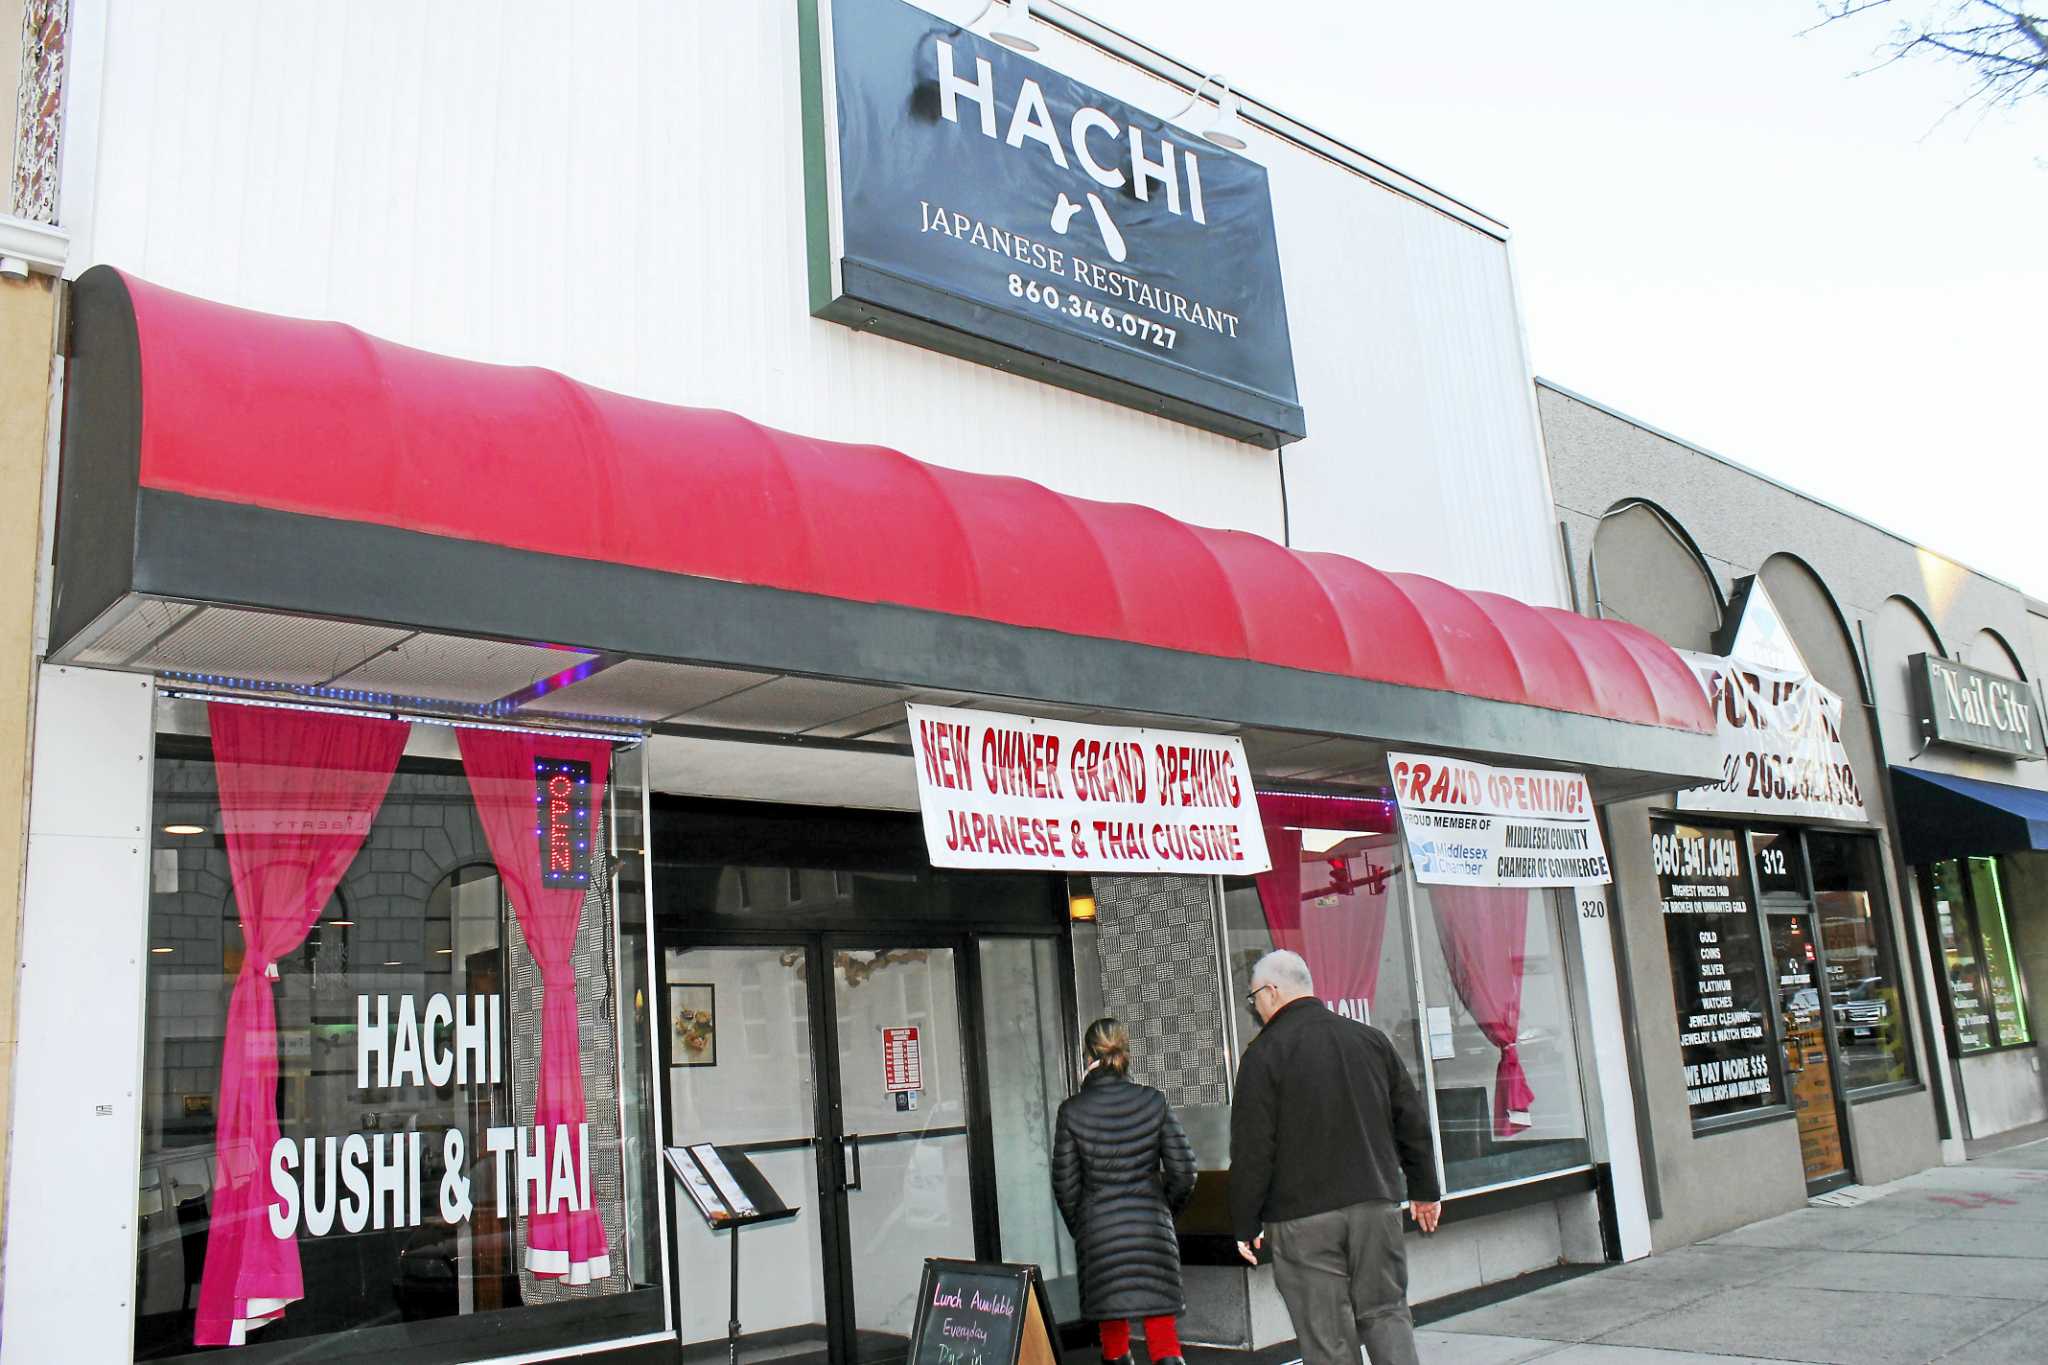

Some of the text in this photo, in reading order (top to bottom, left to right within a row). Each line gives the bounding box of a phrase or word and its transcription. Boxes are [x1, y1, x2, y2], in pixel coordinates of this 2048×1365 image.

[936, 40, 1206, 225] HACHI
[920, 201, 1238, 338] JAPANESE RESTAURANT
[1008, 274, 1177, 351] 860.346.0727
[1941, 668, 2032, 750] Nail City
[920, 719, 1240, 808] NEW OWNER GRAND OPENING
[1394, 761, 1583, 814] GRAND OPENING!
[550, 776, 571, 870] OPEN
[1404, 813, 1491, 831] PROUD MEMBER OF
[946, 809, 1244, 861] JAPANESE & THAI CUISINE
[1505, 825, 1589, 850] MIDDLESEX COUNTY
[1436, 840, 1488, 860] Middlesex
[1762, 850, 1786, 875] 312
[1438, 859, 1483, 876] Chamber
[1498, 856, 1608, 878] CHAMBER OF COMMERCE
[1582, 900, 1604, 918] 320
[1700, 931, 1717, 943] GOLD
[1700, 948, 1720, 959] COINS
[1701, 964, 1725, 976] SILVER
[1699, 980, 1732, 993] PLATINUM
[1701, 996, 1733, 1009] WATCHES
[1688, 1011, 1750, 1028] JEWELRY CLEANING
[357, 992, 500, 1089] HACHI
[1680, 1026, 1763, 1046] JEWELRY & WATCH REPAIR
[1684, 1053, 1768, 1086] WE PAY MORE $$$
[268, 1123, 591, 1240] SUSHI & THAI
[933, 1282, 1014, 1318] Lunch Available
[943, 1318, 988, 1346] Everyday
